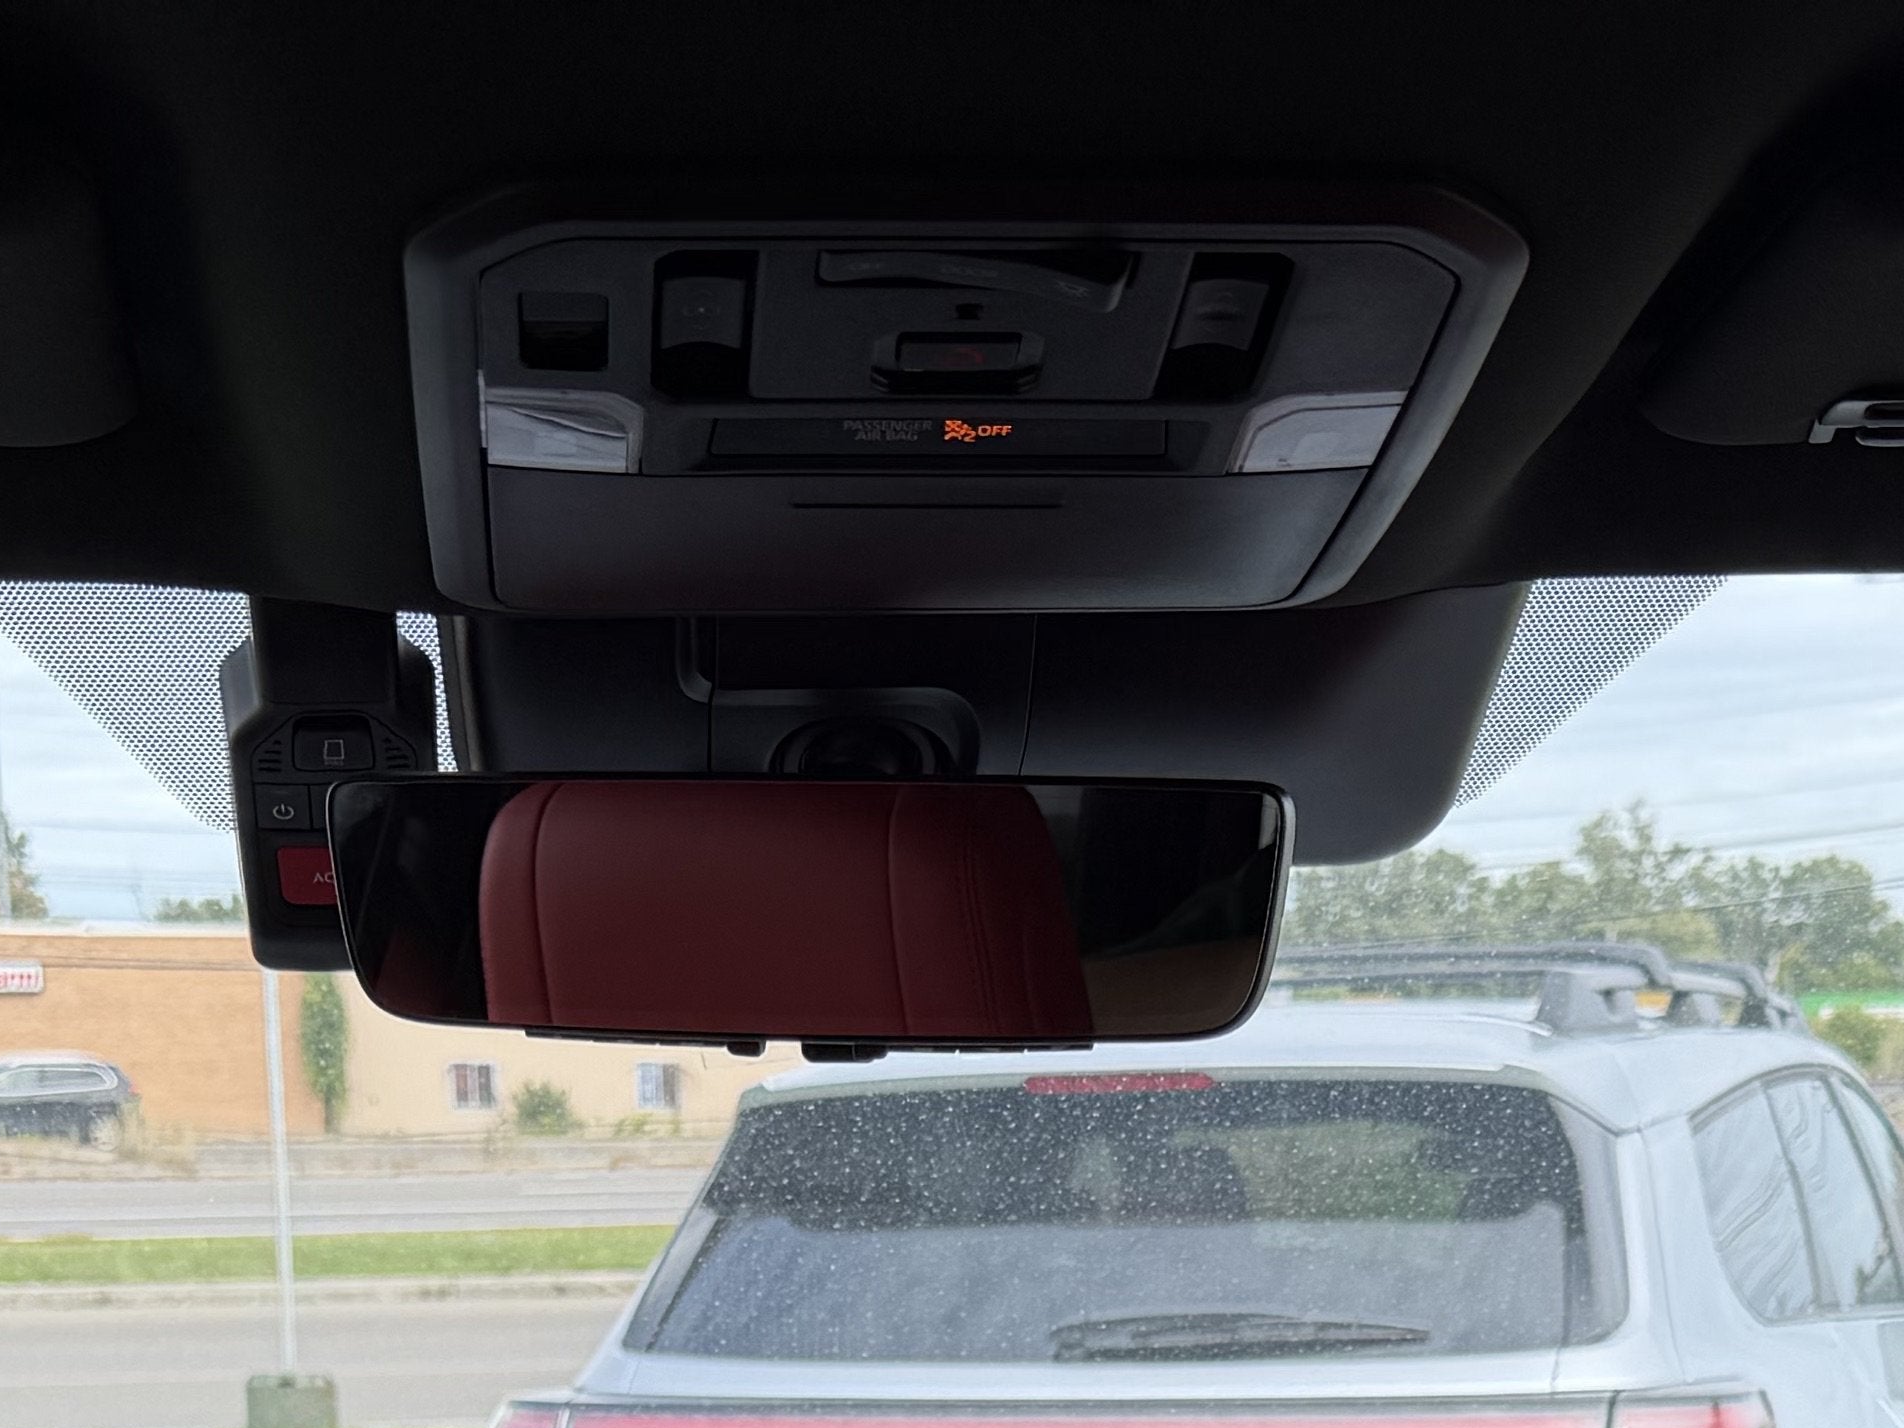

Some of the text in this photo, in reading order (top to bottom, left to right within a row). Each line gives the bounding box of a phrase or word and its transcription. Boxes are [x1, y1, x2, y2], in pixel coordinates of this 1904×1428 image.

[843, 420, 932, 432] PASSENGER
[978, 425, 1013, 437] OFF
[855, 430, 919, 441] AIR BAG
